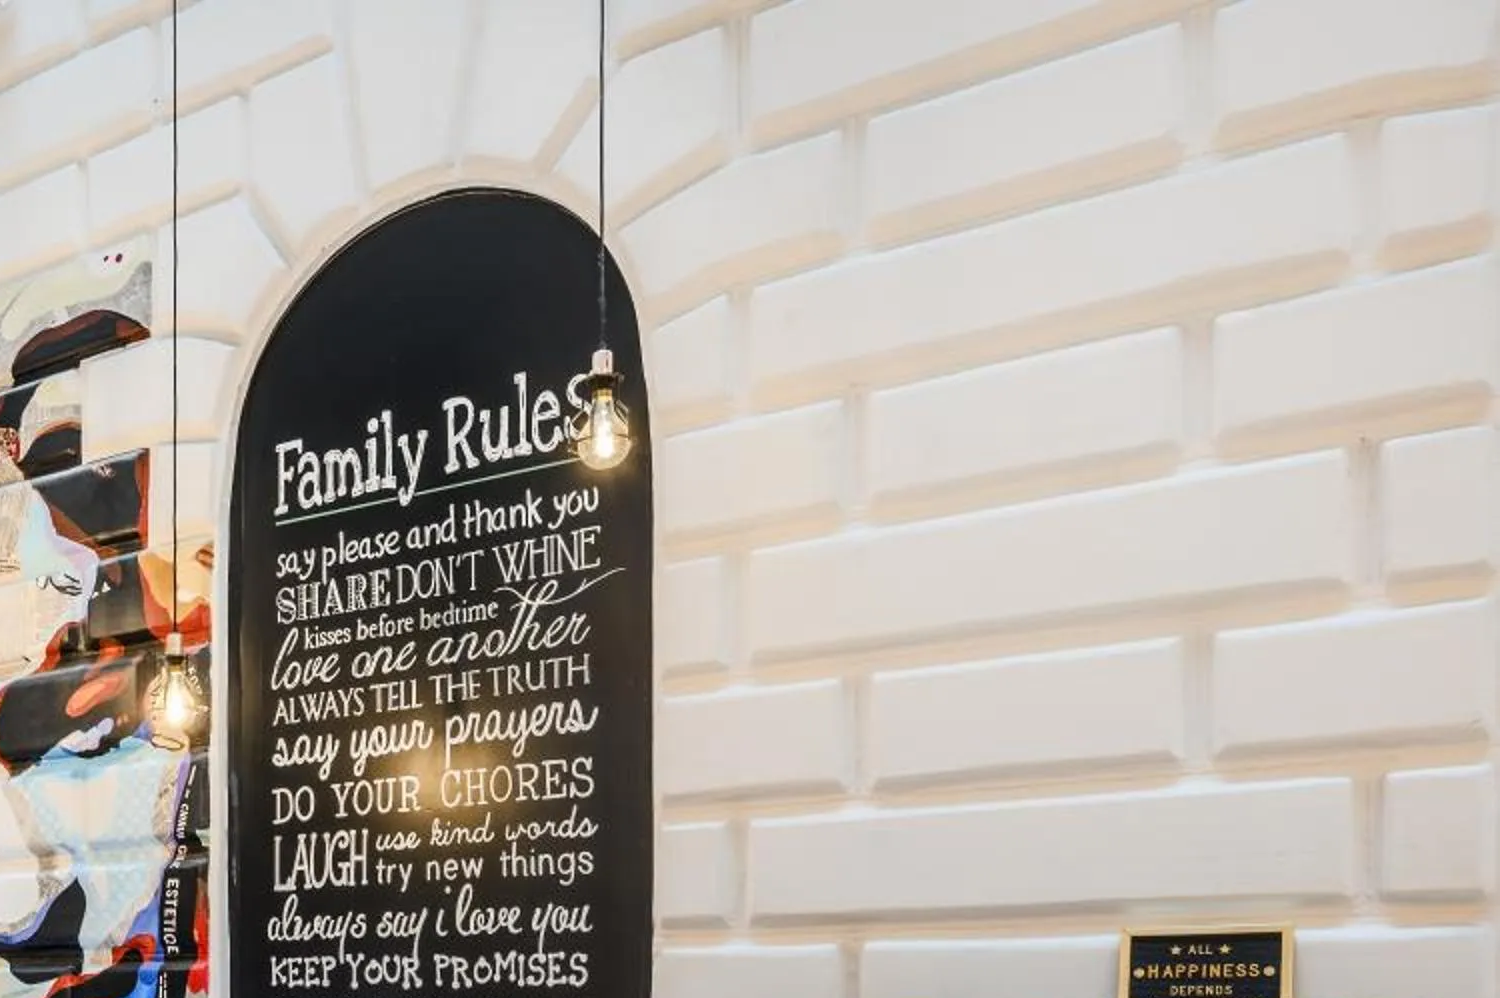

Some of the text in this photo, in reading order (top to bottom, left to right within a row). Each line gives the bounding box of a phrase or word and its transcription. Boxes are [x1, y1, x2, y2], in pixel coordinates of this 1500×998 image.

[275, 410, 428, 515] Family
[276, 485, 600, 579] say please and thank you
[396, 525, 601, 604] DON'T WHINE
[276, 568, 391, 625] SHARE
[304, 601, 498, 649] kisses before bedtime
[272, 627, 340, 691] love
[351, 641, 416, 676] one
[427, 568, 626, 666] another
[273, 653, 591, 727] ALWAYS TELL THE TRUTH
[272, 699, 598, 780] say your prayers
[272, 757, 595, 824] DO YOUR CHORES
[376, 805, 598, 851] use kind words
[273, 829, 369, 892] LAUGH
[376, 843, 594, 891] try new things
[267, 884, 593, 963] always say i love you
[1188, 944, 1213, 955] ALL
[271, 950, 589, 990] KEEP YOUR PROMISES
[1147, 963, 1261, 979] HAPPINESS
[1170, 985, 1233, 997] DEPENDS
